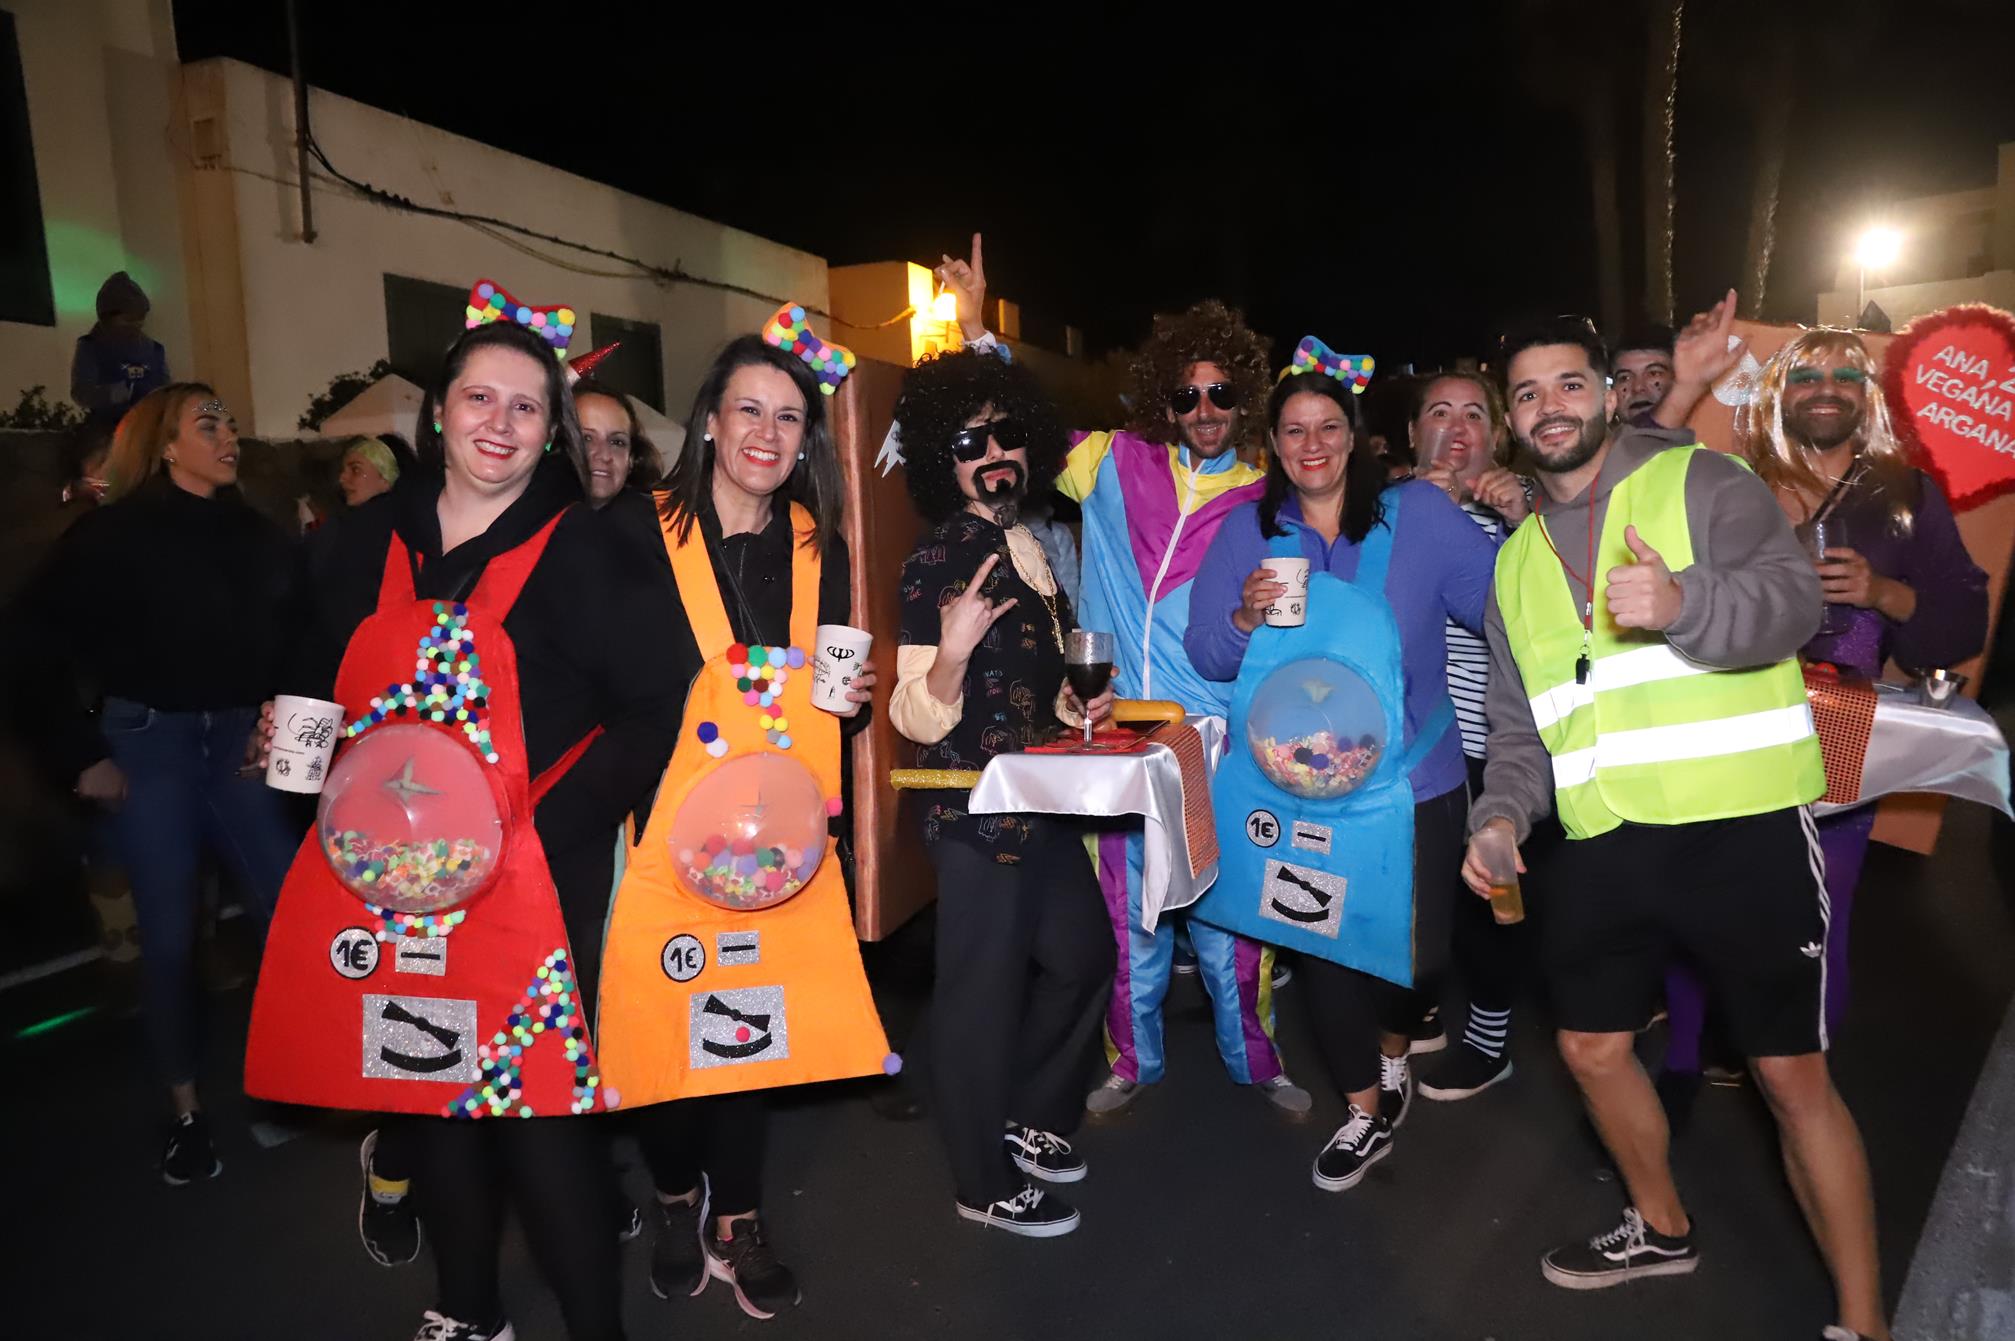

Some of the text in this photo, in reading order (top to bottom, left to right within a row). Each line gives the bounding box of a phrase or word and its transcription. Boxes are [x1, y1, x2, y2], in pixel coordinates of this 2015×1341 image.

[1915, 363, 2014, 422] VEGANA
[335, 939, 373, 971] 1€
[669, 946, 698, 973] 1€
